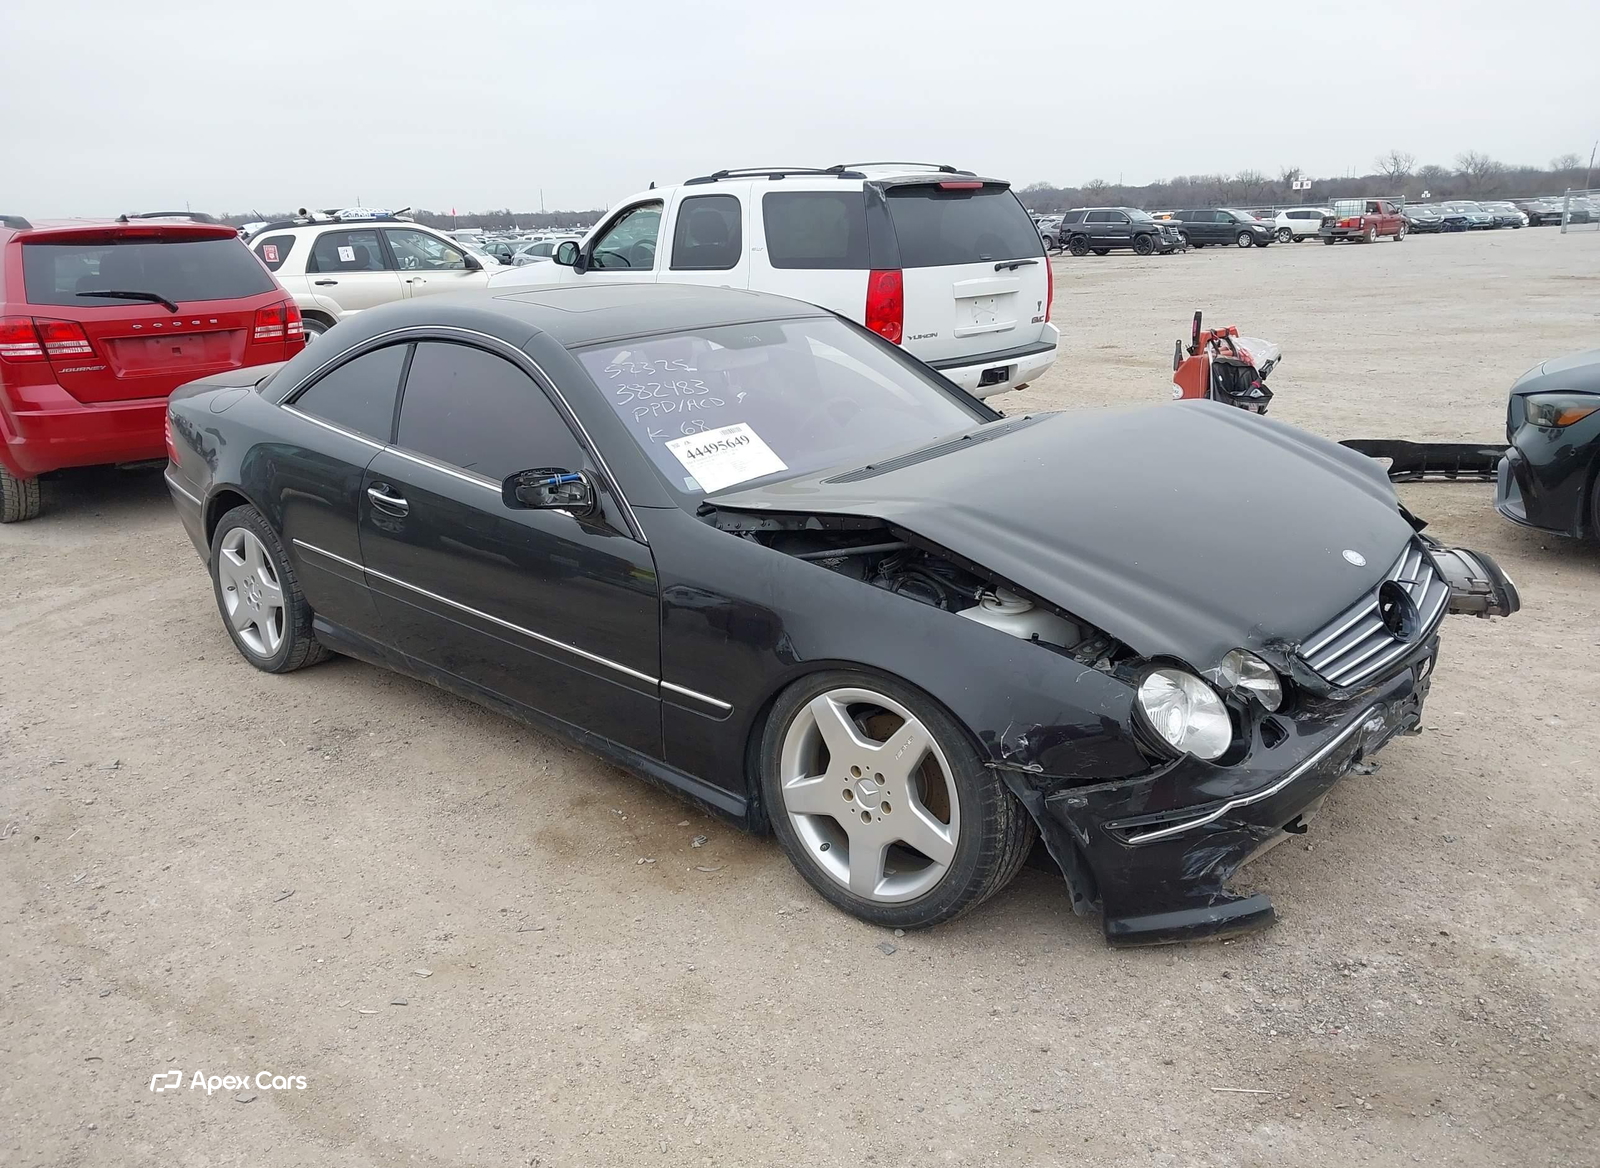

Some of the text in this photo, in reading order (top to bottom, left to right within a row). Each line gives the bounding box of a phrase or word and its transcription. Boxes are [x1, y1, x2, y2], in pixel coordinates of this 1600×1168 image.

[132, 318, 218, 329] DODGE
[907, 332, 938, 341] YUKON
[58, 365, 107, 374] JOURNEY
[616, 379, 710, 406] 382483
[686, 434, 751, 460] 44495649
